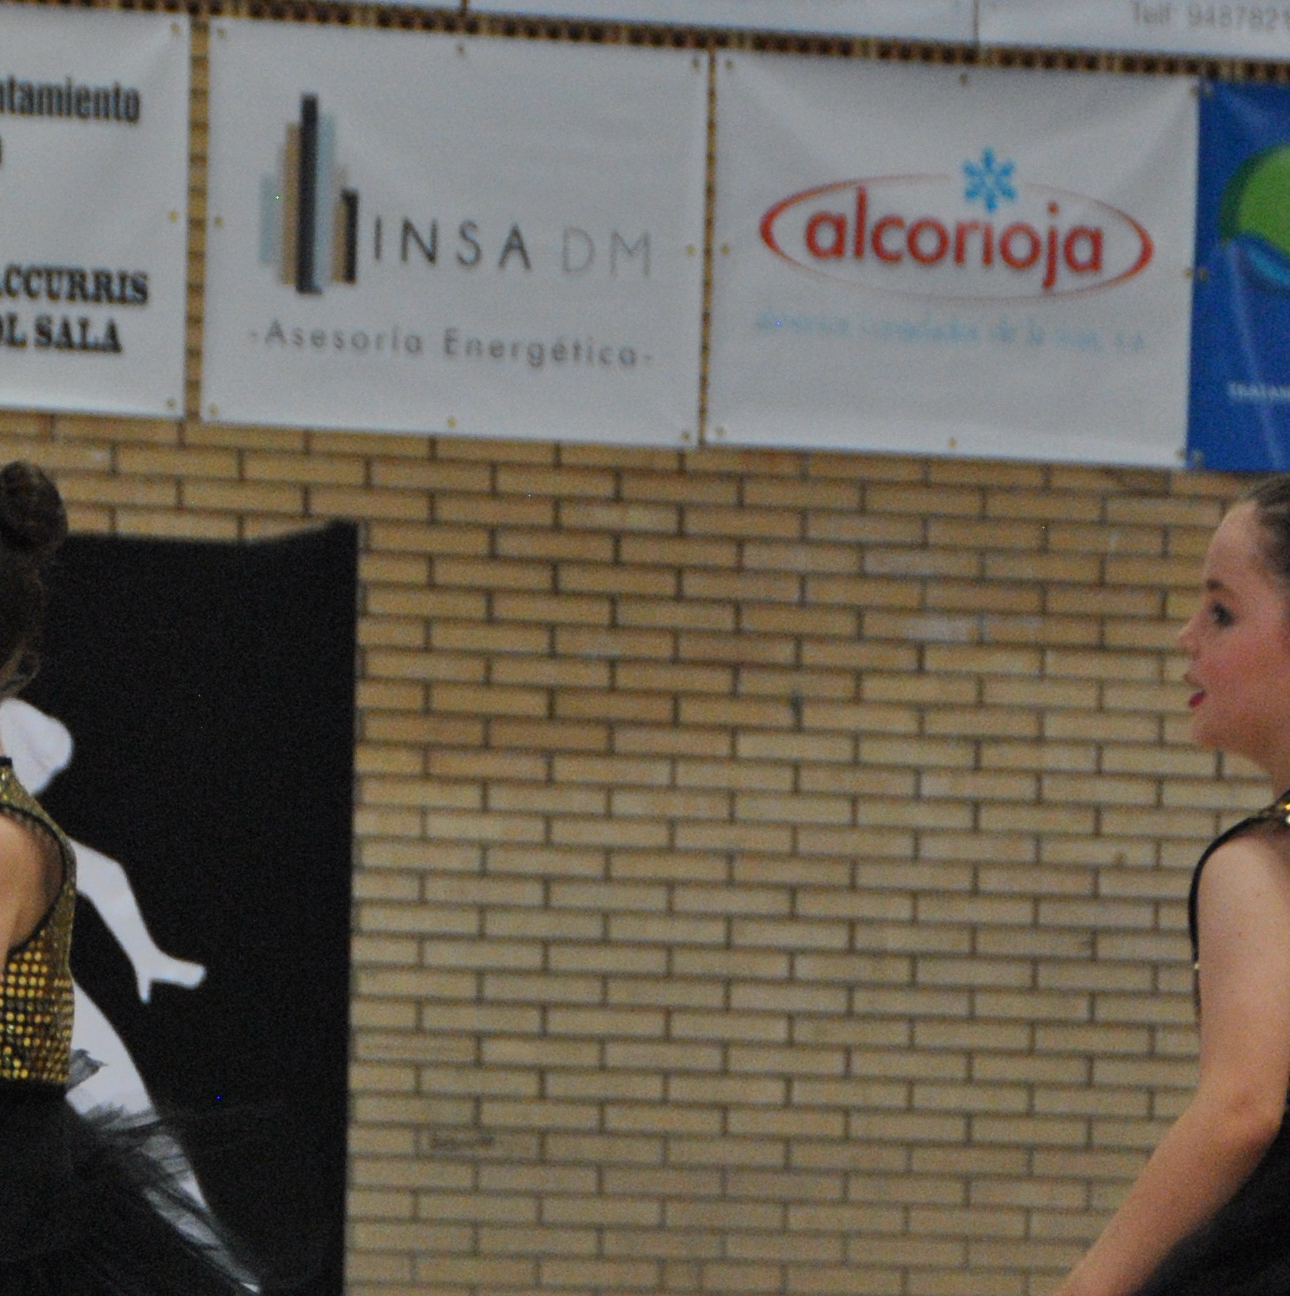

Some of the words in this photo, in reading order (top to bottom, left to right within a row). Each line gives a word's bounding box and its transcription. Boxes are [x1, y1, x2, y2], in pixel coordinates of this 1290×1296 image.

[373, 213, 533, 272] INSA
[562, 227, 653, 279] DM
[805, 184, 1105, 292] alcorioja
[33, 313, 124, 355] SALA
